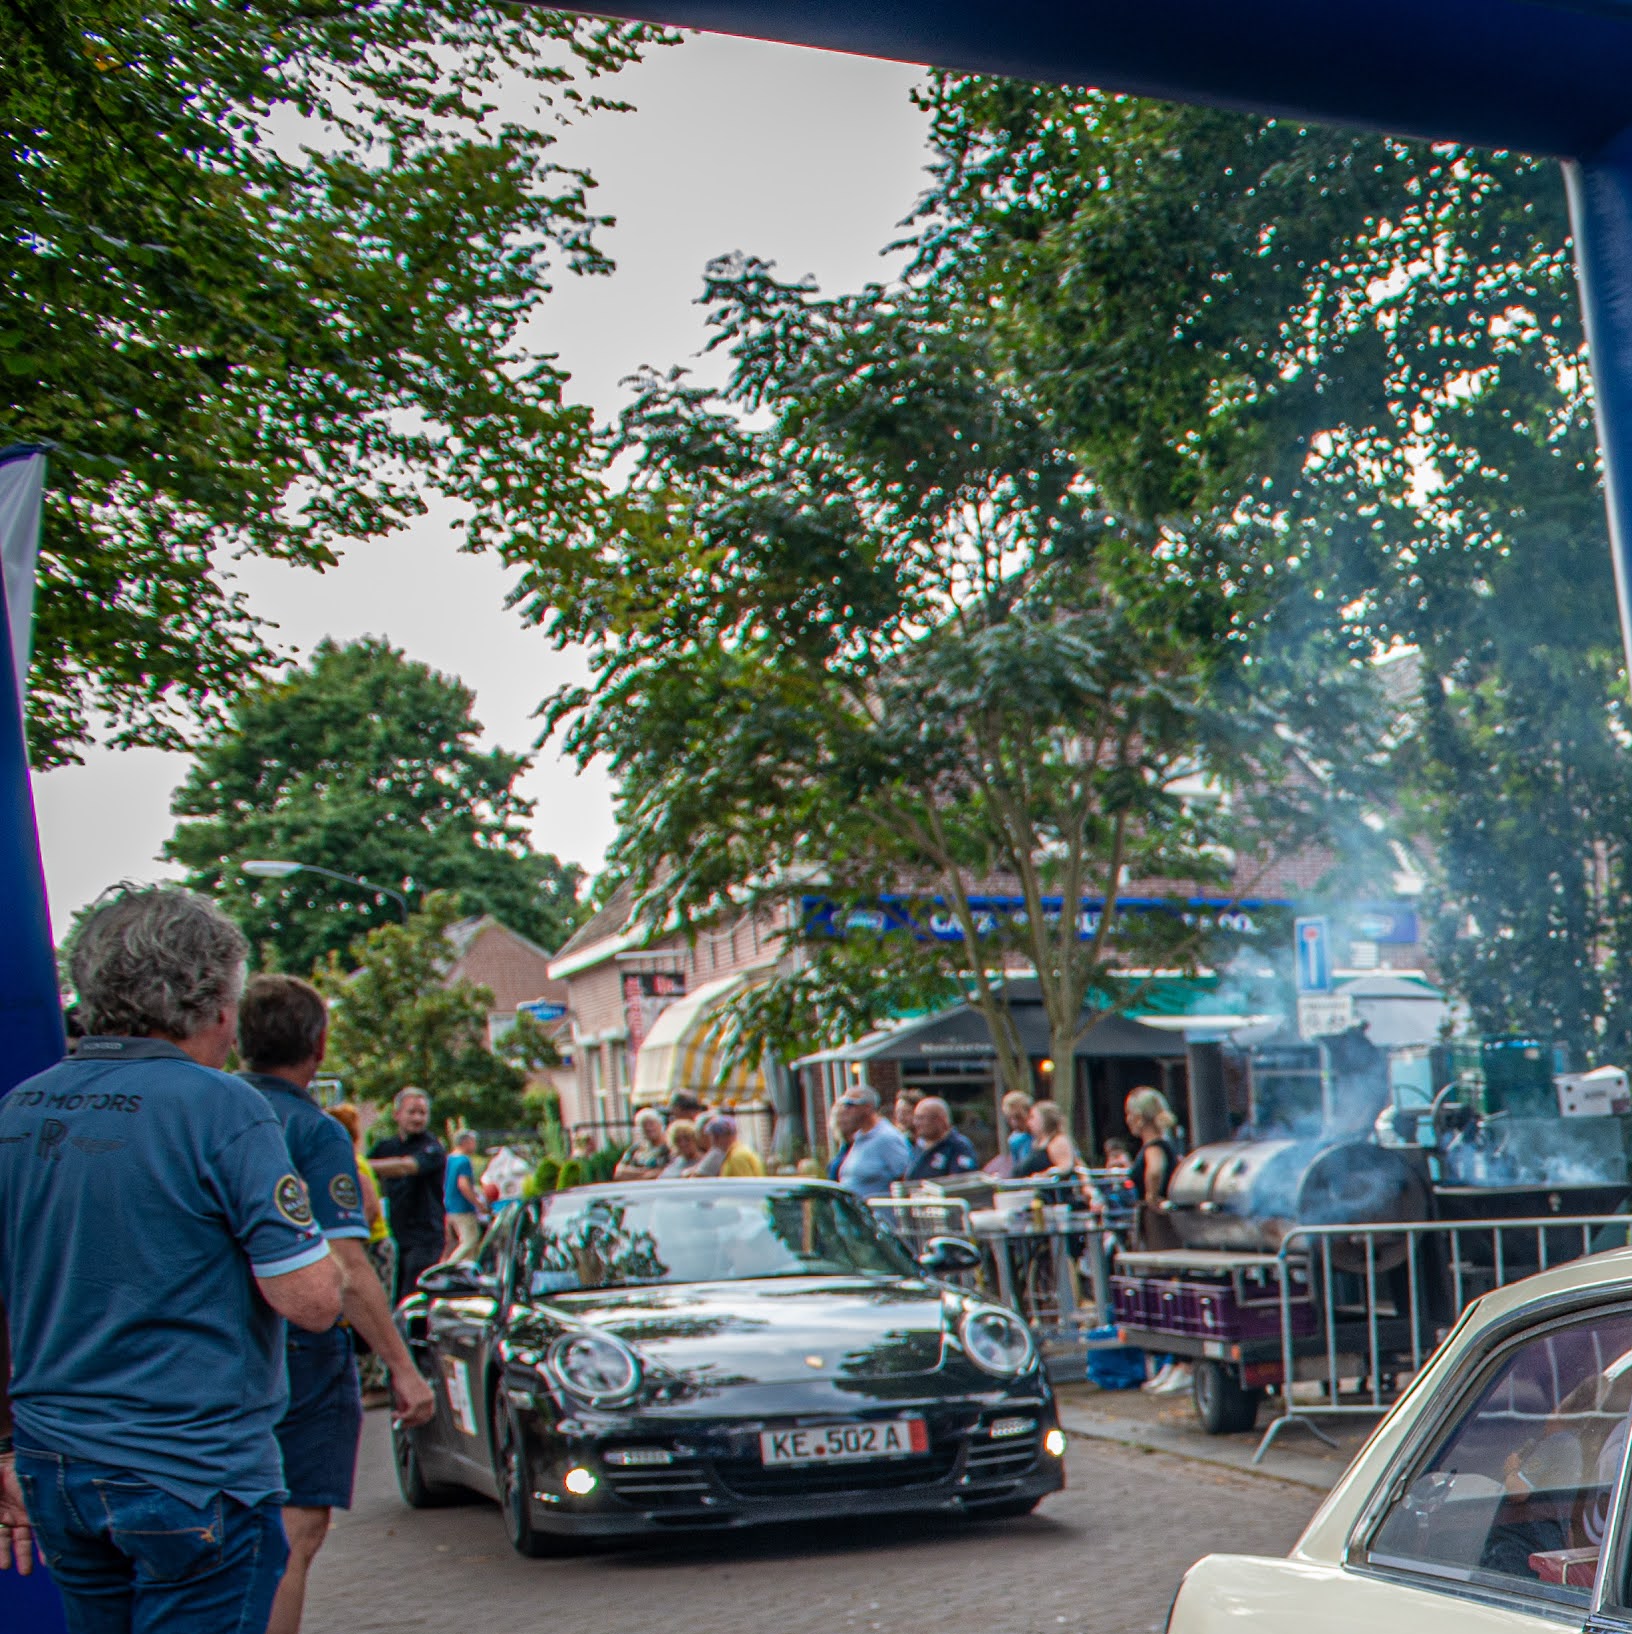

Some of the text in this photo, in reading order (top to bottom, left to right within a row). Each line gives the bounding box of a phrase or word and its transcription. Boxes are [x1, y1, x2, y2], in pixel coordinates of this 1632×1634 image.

[46, 1091, 144, 1113] MOTORS
[771, 1432, 810, 1459] KE
[826, 1427, 877, 1455] 502
